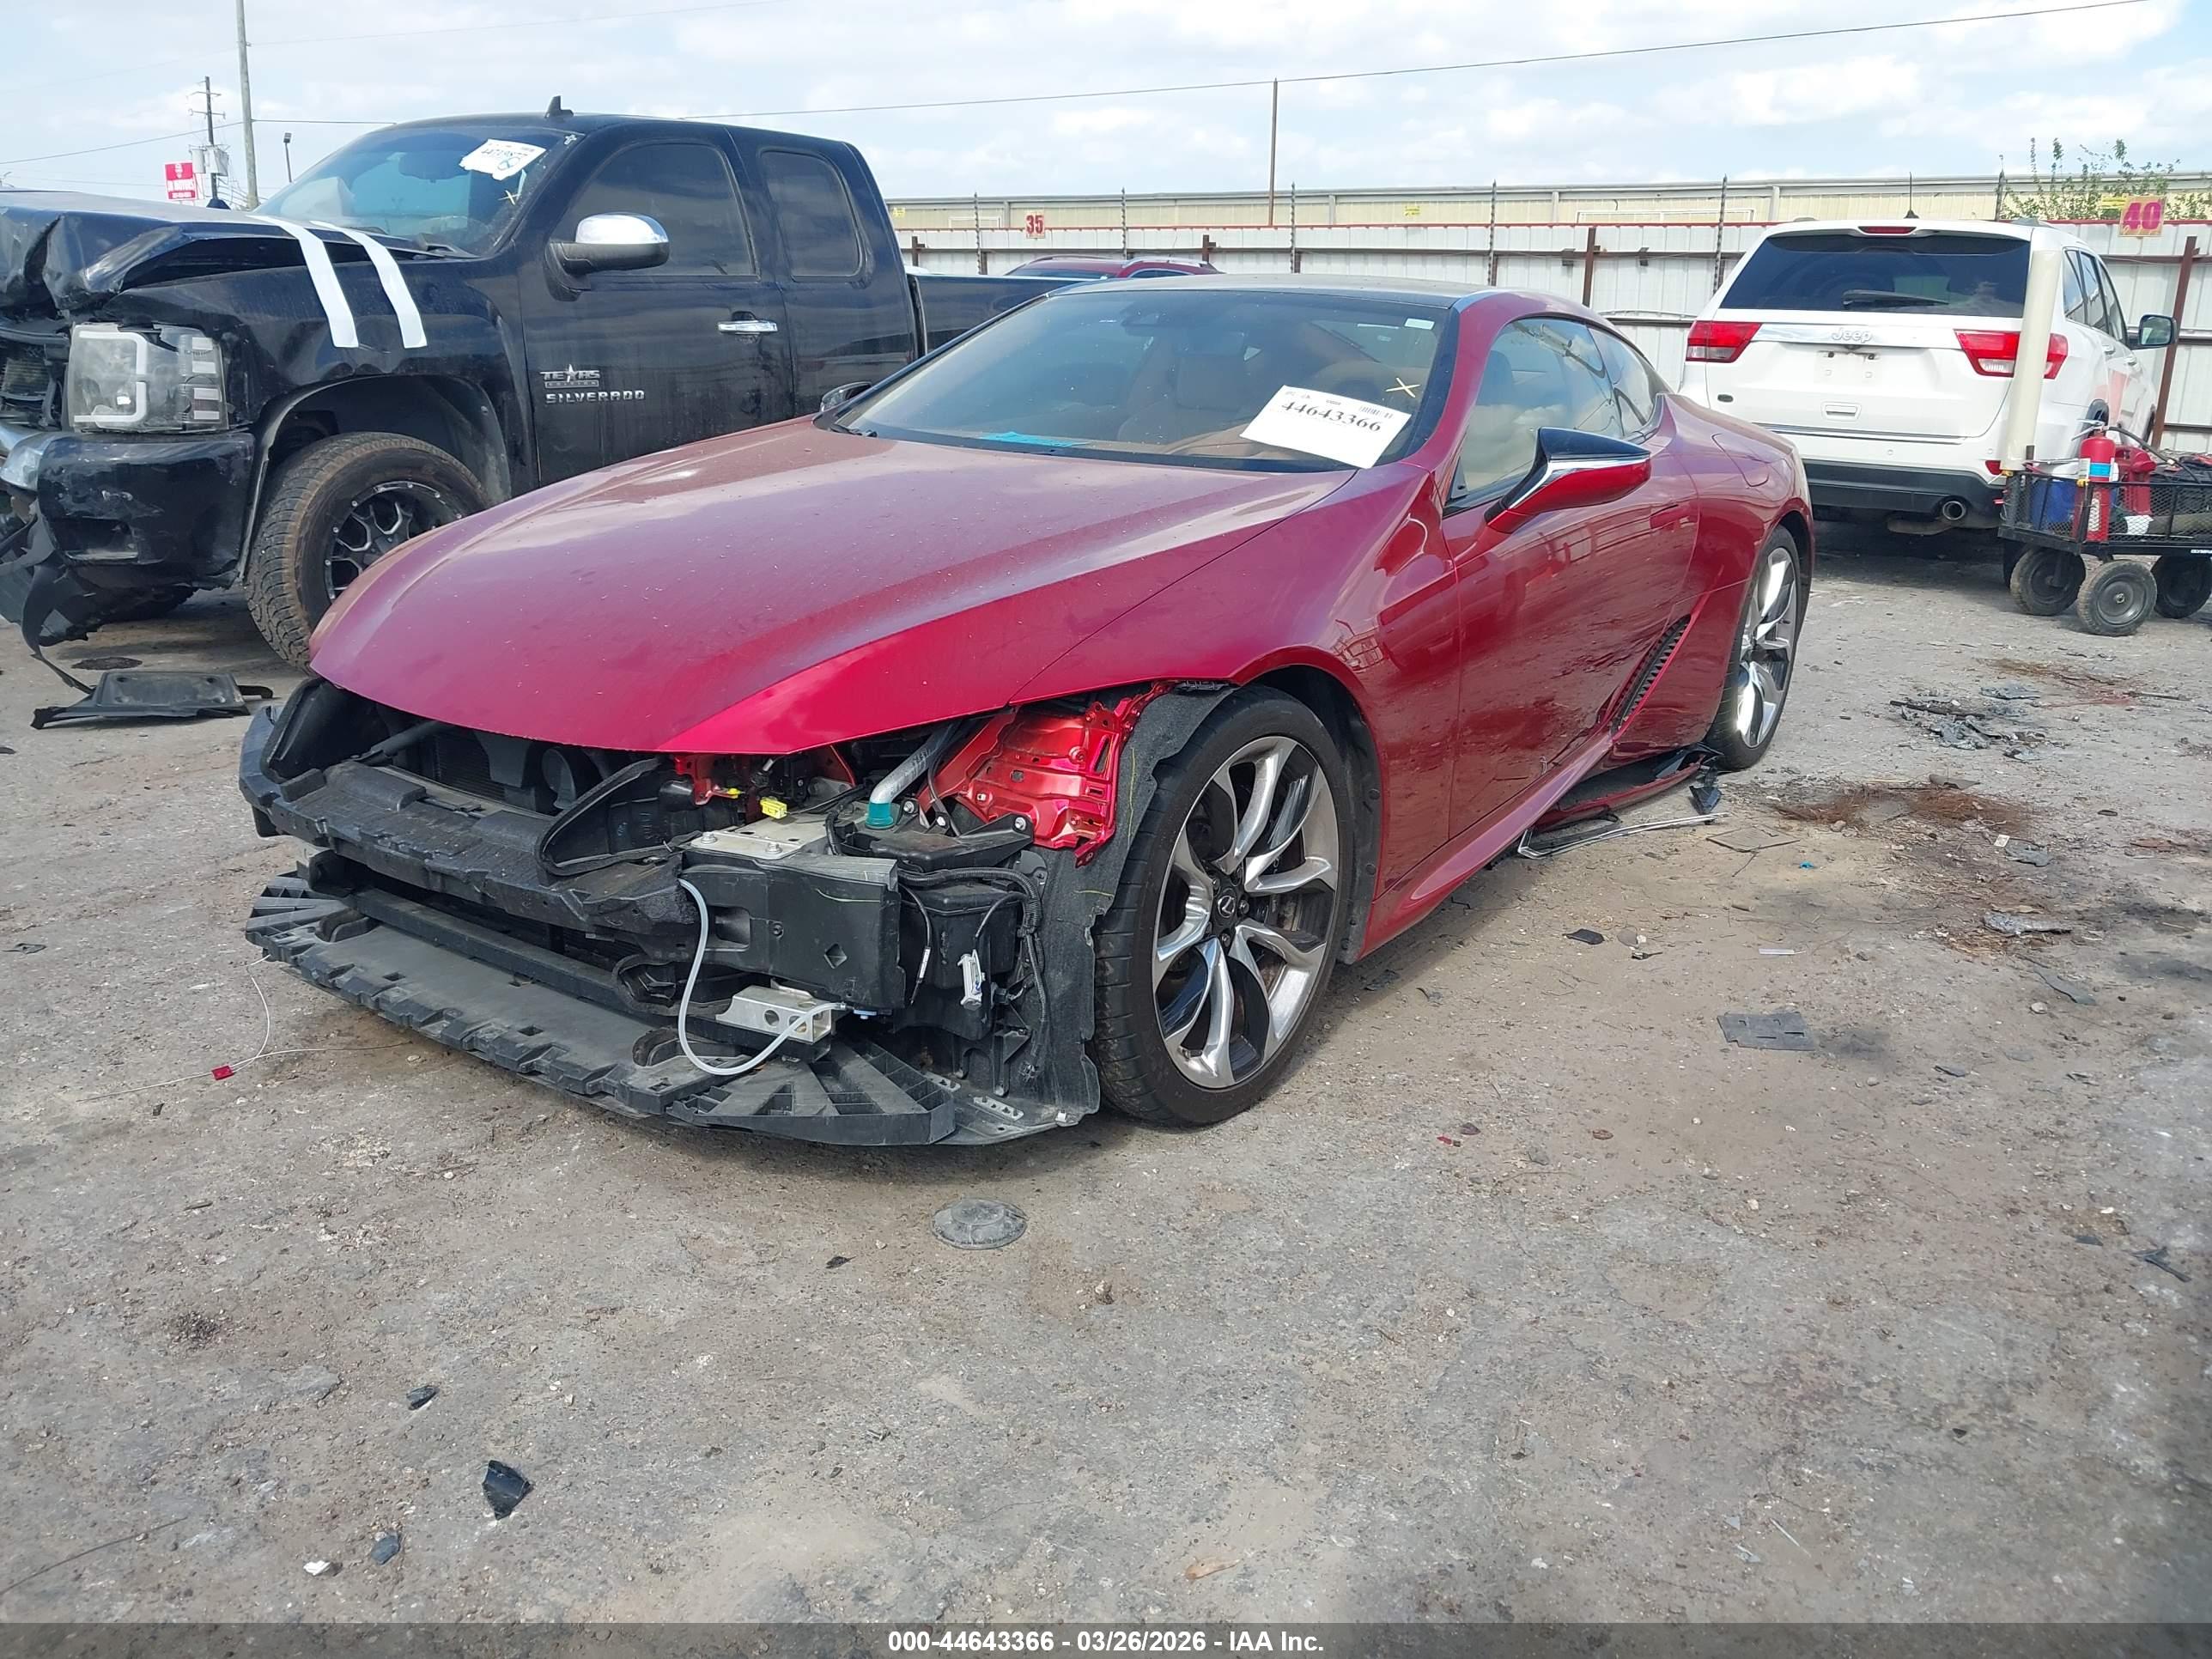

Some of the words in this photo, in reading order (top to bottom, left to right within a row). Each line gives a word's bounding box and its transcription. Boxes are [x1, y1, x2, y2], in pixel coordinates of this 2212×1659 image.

[1026, 215, 1043, 234] 35
[2124, 202, 2161, 229] 40
[1832, 327, 1873, 343] Jeep
[546, 390, 645, 404] SILVERADO
[1282, 401, 1381, 431] 44643366
